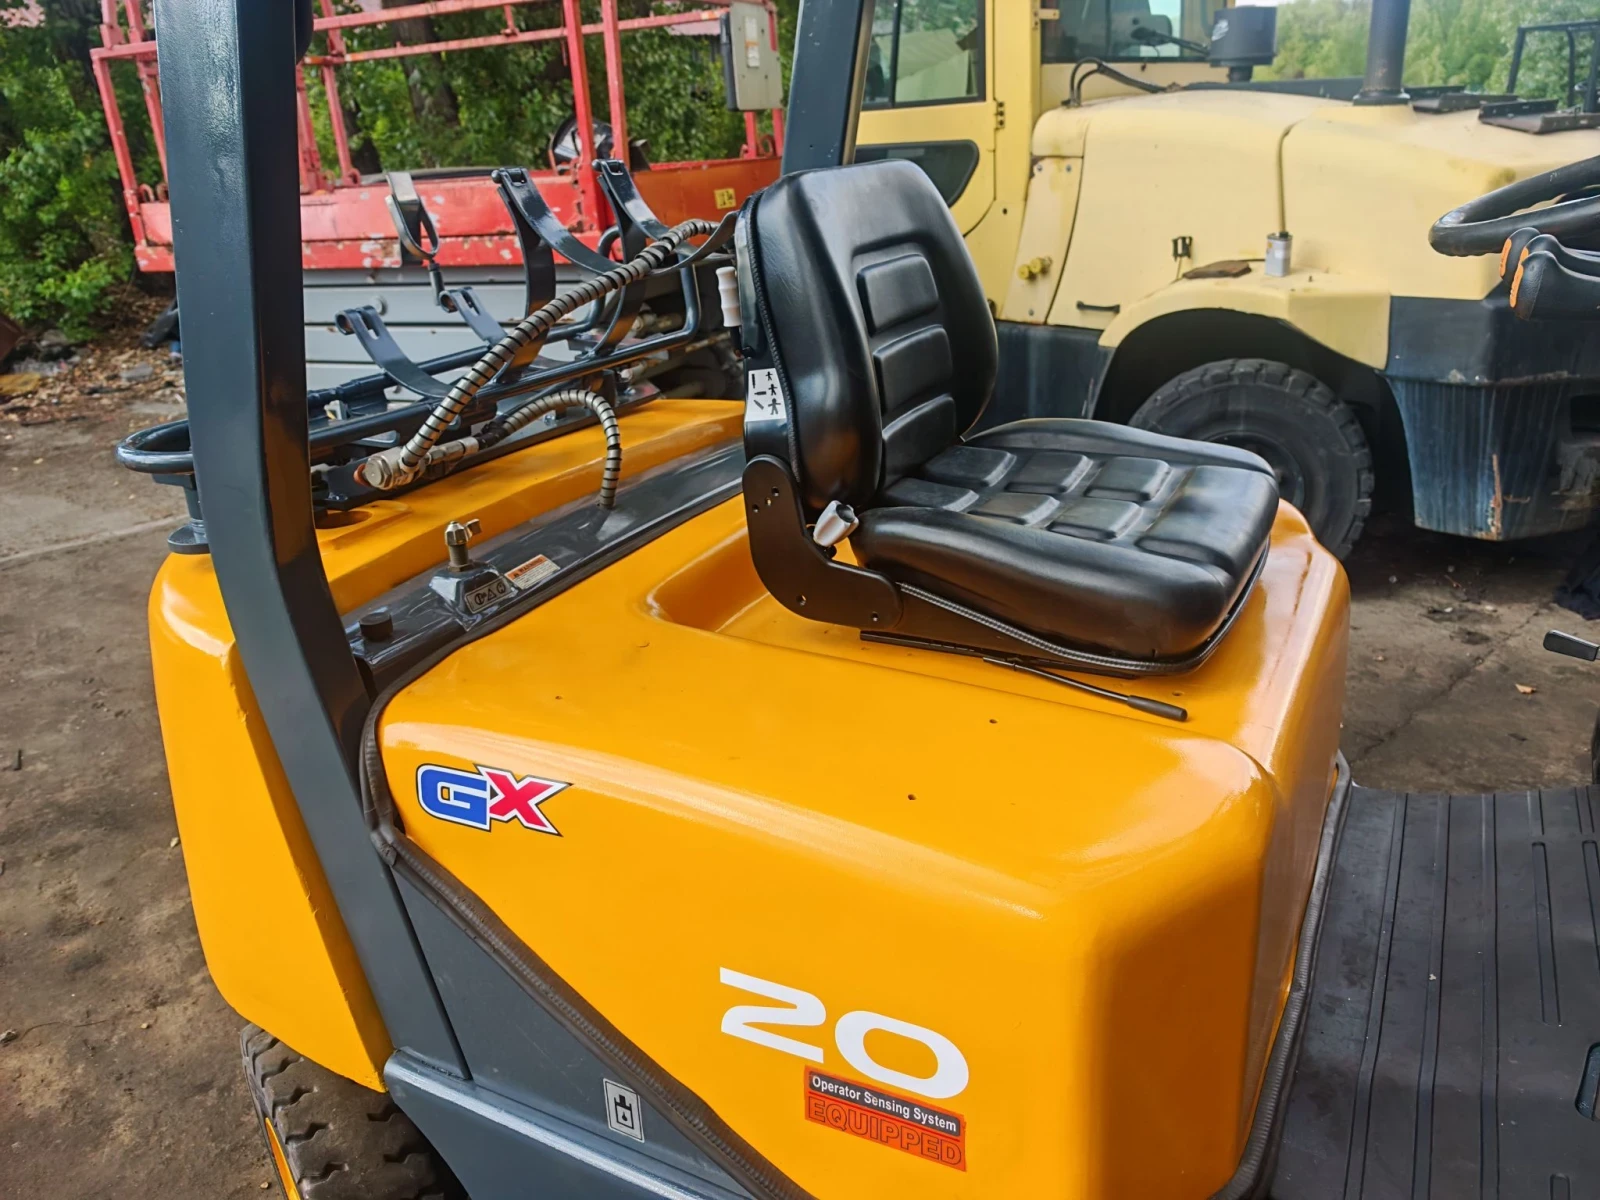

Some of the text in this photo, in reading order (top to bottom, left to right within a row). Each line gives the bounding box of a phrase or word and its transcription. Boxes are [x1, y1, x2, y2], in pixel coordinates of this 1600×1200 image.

[416, 763, 573, 837] GX
[719, 966, 970, 1099] 20
[808, 1096, 962, 1166] EQUIPPED
[812, 1075, 957, 1132] Operator Sensing System
